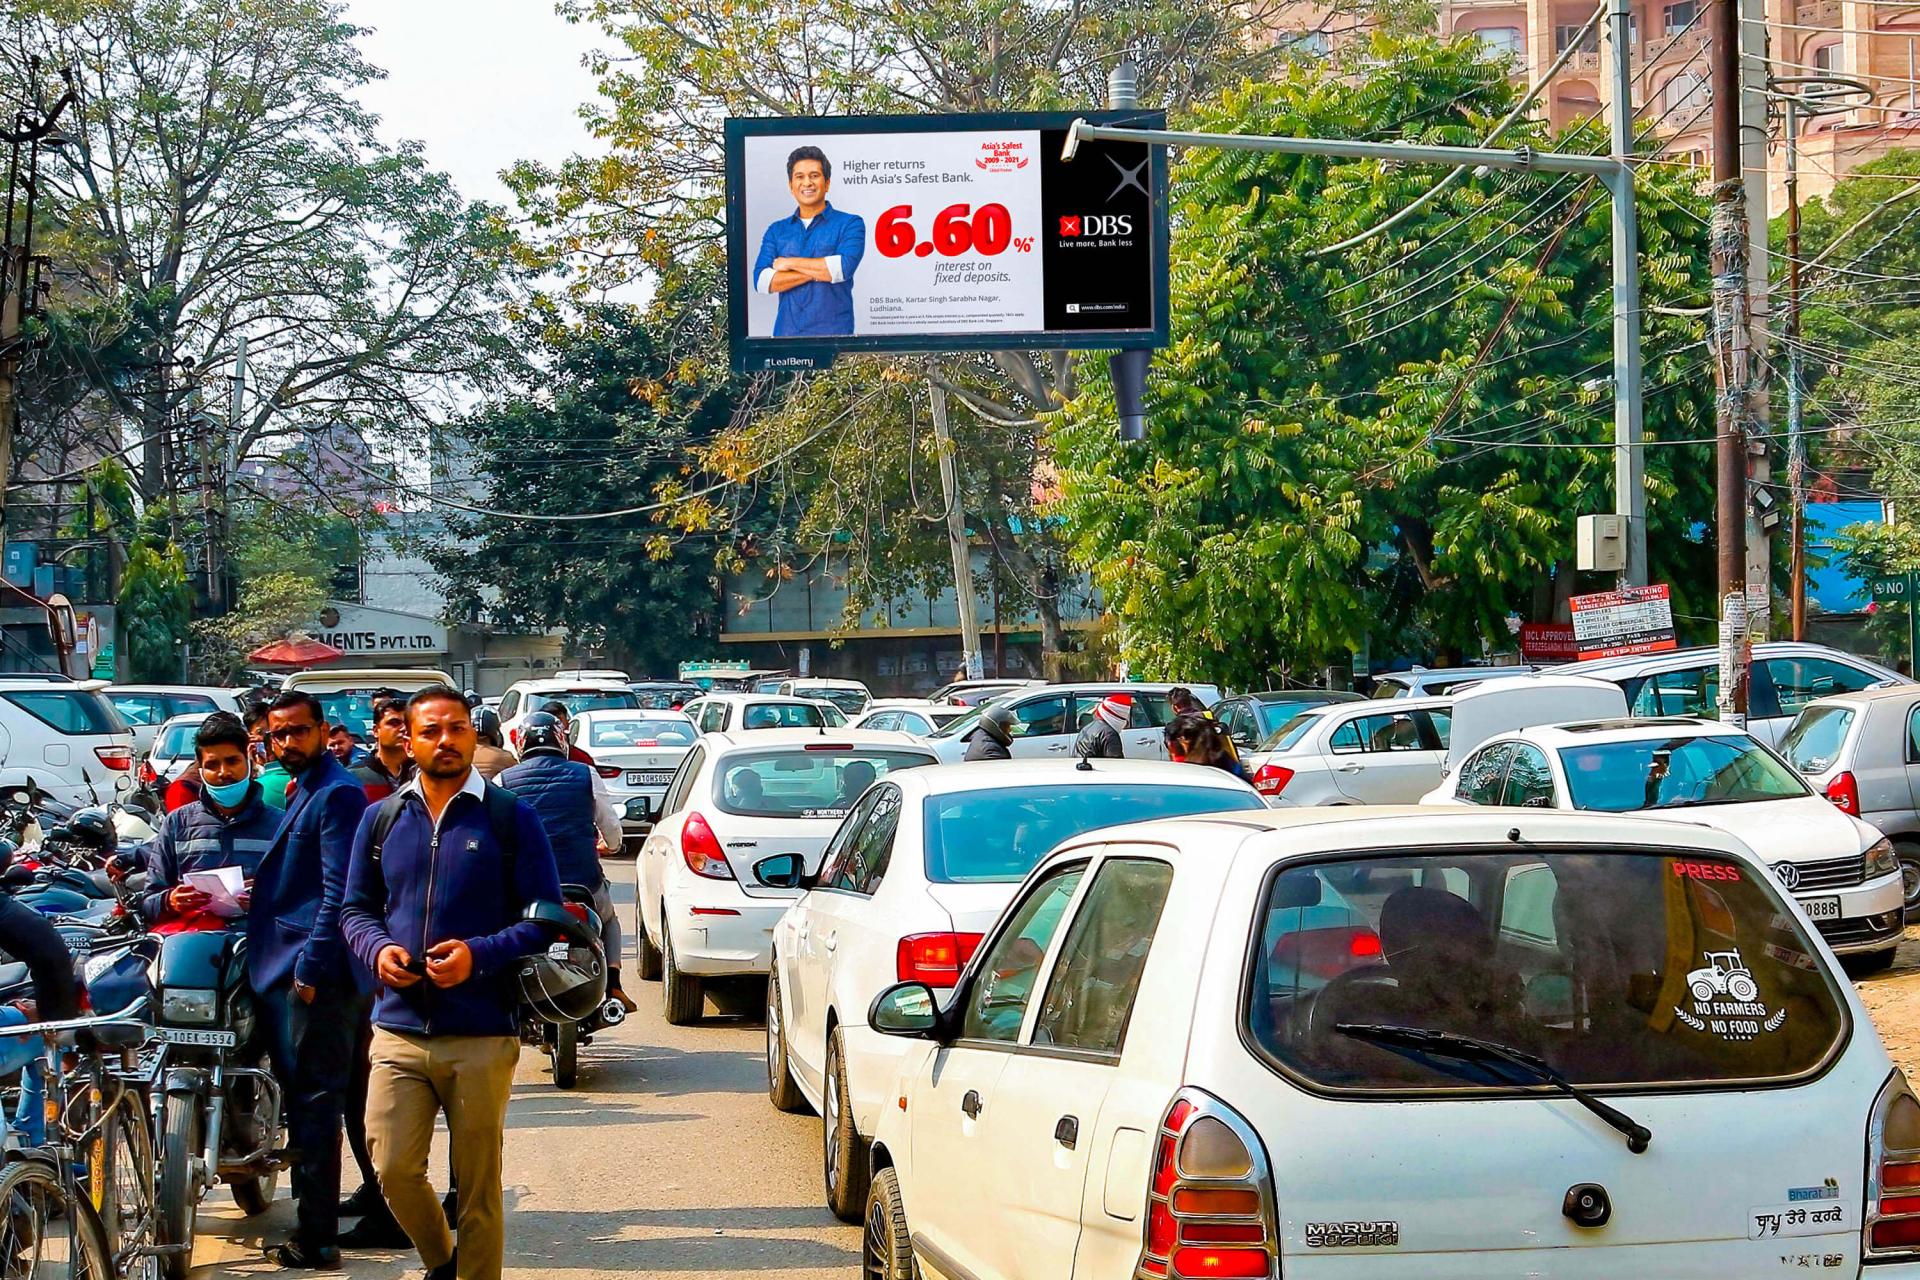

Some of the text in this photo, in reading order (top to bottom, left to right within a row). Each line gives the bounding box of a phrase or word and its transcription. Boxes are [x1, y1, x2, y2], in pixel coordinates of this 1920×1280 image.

[982, 141, 1023, 150] Asia's Safest
[993, 149, 1011, 157] Bank
[843, 160, 926, 173] Higher returns
[1004, 156, 1019, 164] 2021
[843, 172, 974, 185] with Asia's Safest Bank.
[1083, 214, 1133, 236] DBS
[1059, 239, 1133, 248] Live more, Bank less
[934, 261, 992, 272] interest on
[933, 271, 1012, 286] fixed deposits.
[885, 296, 904, 305] Bank,
[928, 295, 947, 304] Singh
[948, 294, 977, 303] Sarabha
[978, 294, 1001, 303] Nagar,
[869, 304, 904, 313] Ludhiana.
[770, 357, 814, 368] LeafBerry
[1886, 581, 1904, 594] NO
[379, 635, 407, 649] PVT.
[409, 634, 436, 648] LTD.
[632, 774, 674, 783] PB10HS055
[1672, 862, 1741, 881] PRESS
[1801, 902, 1836, 917] 0888
[1694, 1001, 1767, 1016] NO FARMERS
[1710, 1020, 1759, 1034] NO FOOD
[1789, 1188, 1824, 1201] Bharat
[1306, 1221, 1399, 1235] MARUTI
[1306, 1234, 1399, 1247] SUZUKI
